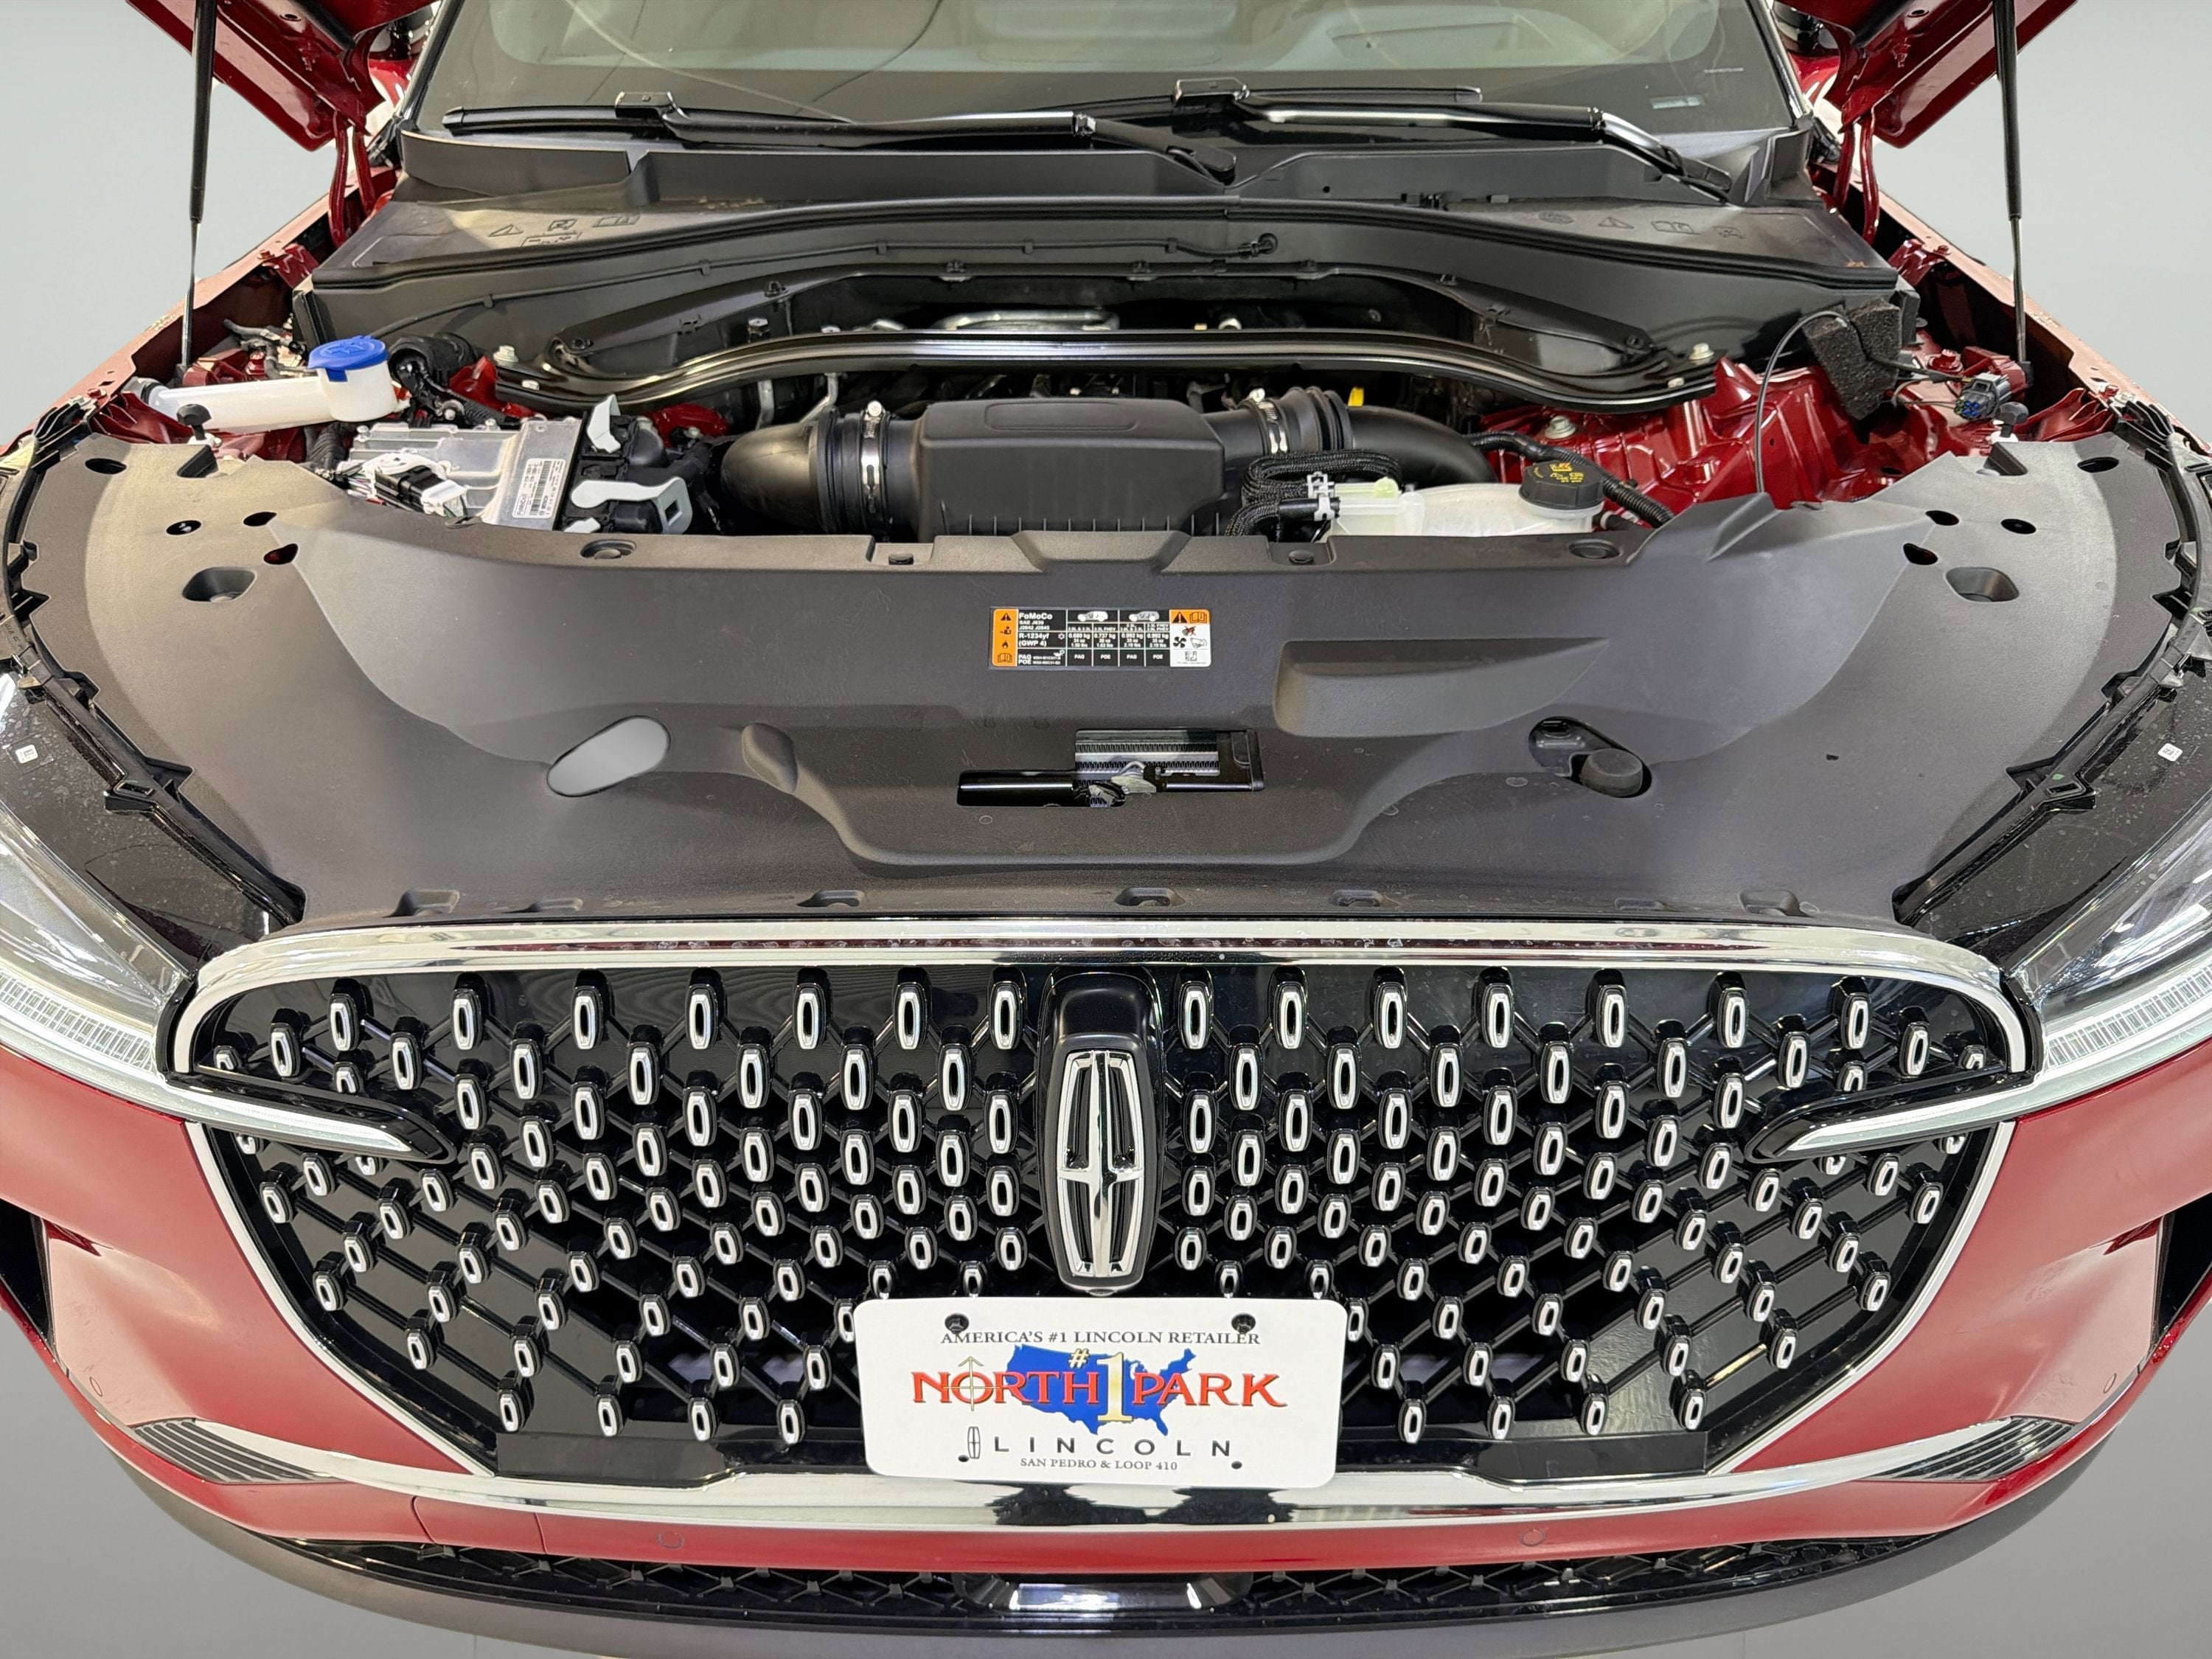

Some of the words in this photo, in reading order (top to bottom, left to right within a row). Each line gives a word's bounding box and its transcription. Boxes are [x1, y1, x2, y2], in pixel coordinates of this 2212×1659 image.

[1019, 612, 1053, 620] FoMoCo
[941, 1331, 1043, 1343] AMERICA'S
[1048, 1332, 1068, 1343] #1
[1073, 1332, 1163, 1344] LINCOLN
[1168, 1332, 1261, 1345] RETAILER
[911, 1371, 1099, 1405] NORTH
[1132, 1372, 1288, 1408] PARK
[994, 1436, 1231, 1457] LINCOLN
[1020, 1457, 1047, 1467] SAN
[1050, 1458, 1097, 1469] PEDRO
[1099, 1459, 1112, 1469] &
[1115, 1460, 1152, 1470] LOOP
[1155, 1461, 1178, 1471] 410
